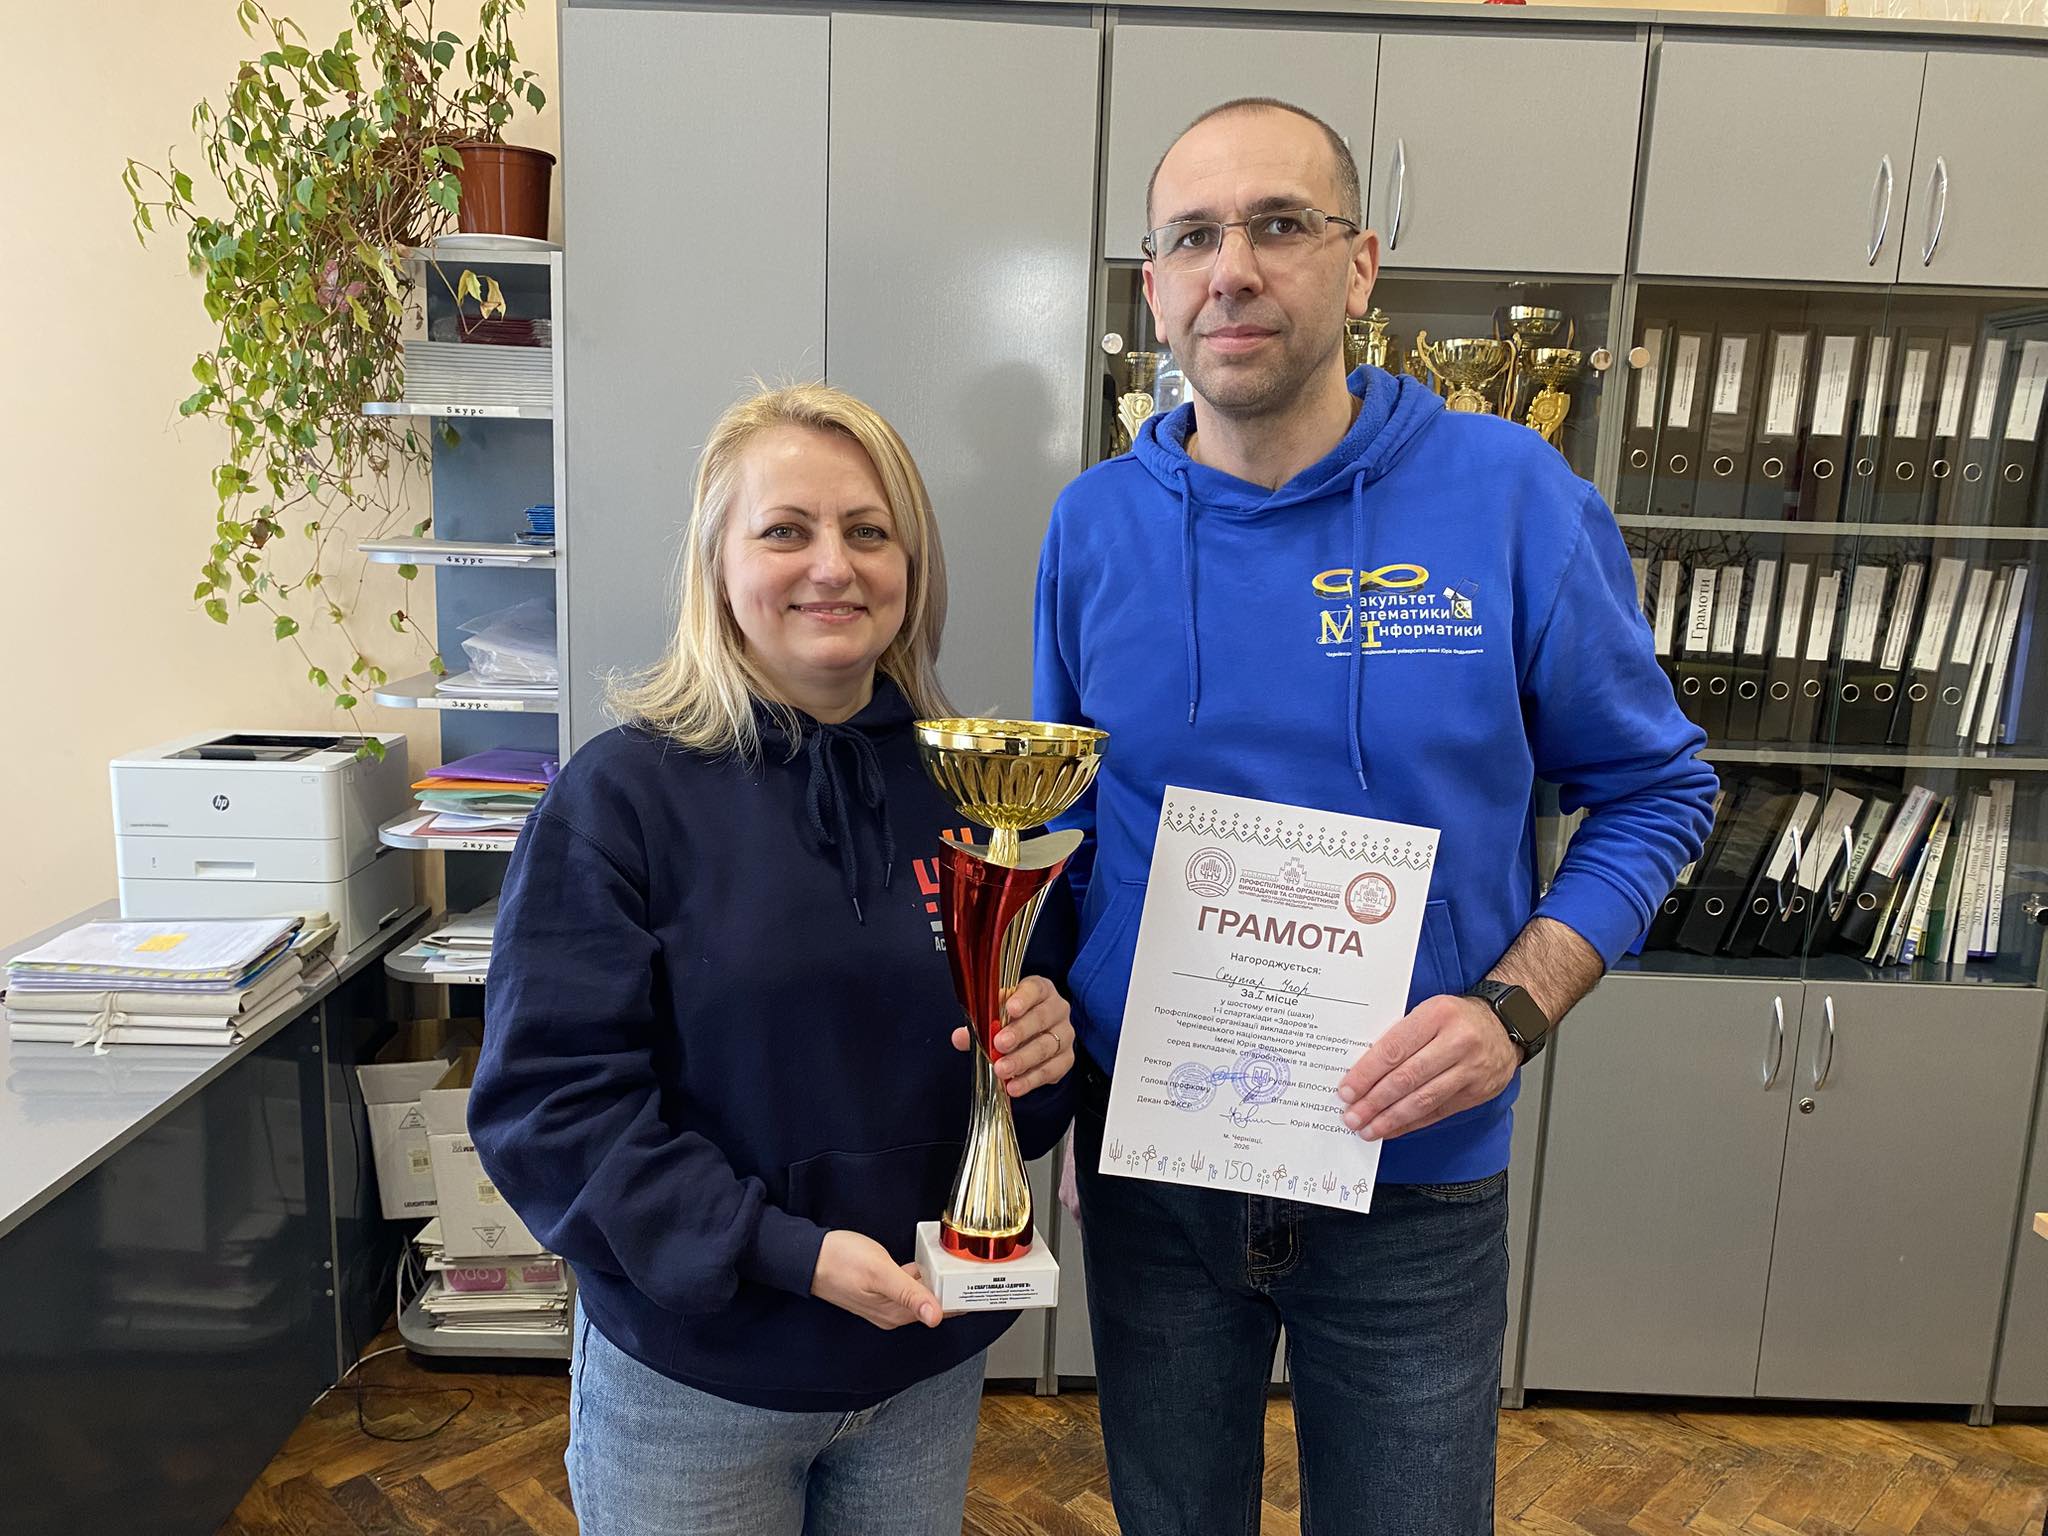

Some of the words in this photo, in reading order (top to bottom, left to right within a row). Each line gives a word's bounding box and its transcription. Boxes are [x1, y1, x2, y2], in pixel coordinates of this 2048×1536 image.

[1691, 578, 1711, 640] Грамоти
[212, 794, 230, 811] hp
[1238, 884, 1279, 896] ВИКЛАДАЧІВ
[1287, 892, 1339, 906] СПІВРОБІТНИКІВ
[1239, 877, 1295, 892] ПРОФСПІЛКОВА
[1295, 886, 1341, 899] ОРГАНІЗАЦІЯ
[1197, 905, 1364, 958] ГРАМОТА
[1230, 952, 1322, 975] Нагороджується:
[1240, 988, 1254, 999] За
[1265, 993, 1299, 1006] місце
[1223, 1008, 1272, 1023] спартакіади
[1227, 1000, 1264, 1012] шостому
[1264, 1005, 1285, 1015] етапі
[1287, 1009, 1315, 1020] (шахи)
[1154, 1006, 1215, 1022] Профспілкової
[1215, 1017, 1259, 1030] організації
[1260, 1025, 1304, 1038] викладачів
[1316, 1034, 1373, 1048] співробітників
[1176, 1019, 1235, 1035] Чернівецького
[1236, 1030, 1295, 1046] національного
[1296, 1041, 1349, 1056] університету
[1166, 1038, 1191, 1048] серед
[1239, 1050, 1297, 1065] співробітників
[1214, 1035, 1236, 1044] імені
[1236, 1039, 1257, 1048] Юрія
[1257, 1043, 1306, 1057] Федьковича
[1143, 1056, 1172, 1067] Ректор
[1140, 1075, 1168, 1086] Голова
[1169, 1081, 1211, 1093] профкому
[1137, 1095, 1161, 1104] Декан
[1271, 1096, 1299, 1107] Віталій
[1289, 1119, 1310, 1129] Юрій
[1311, 1123, 1357, 1136] МОСЕЙЧУК
[1233, 1142, 1250, 1151] 2026
[1224, 1159, 1254, 1182] 150
